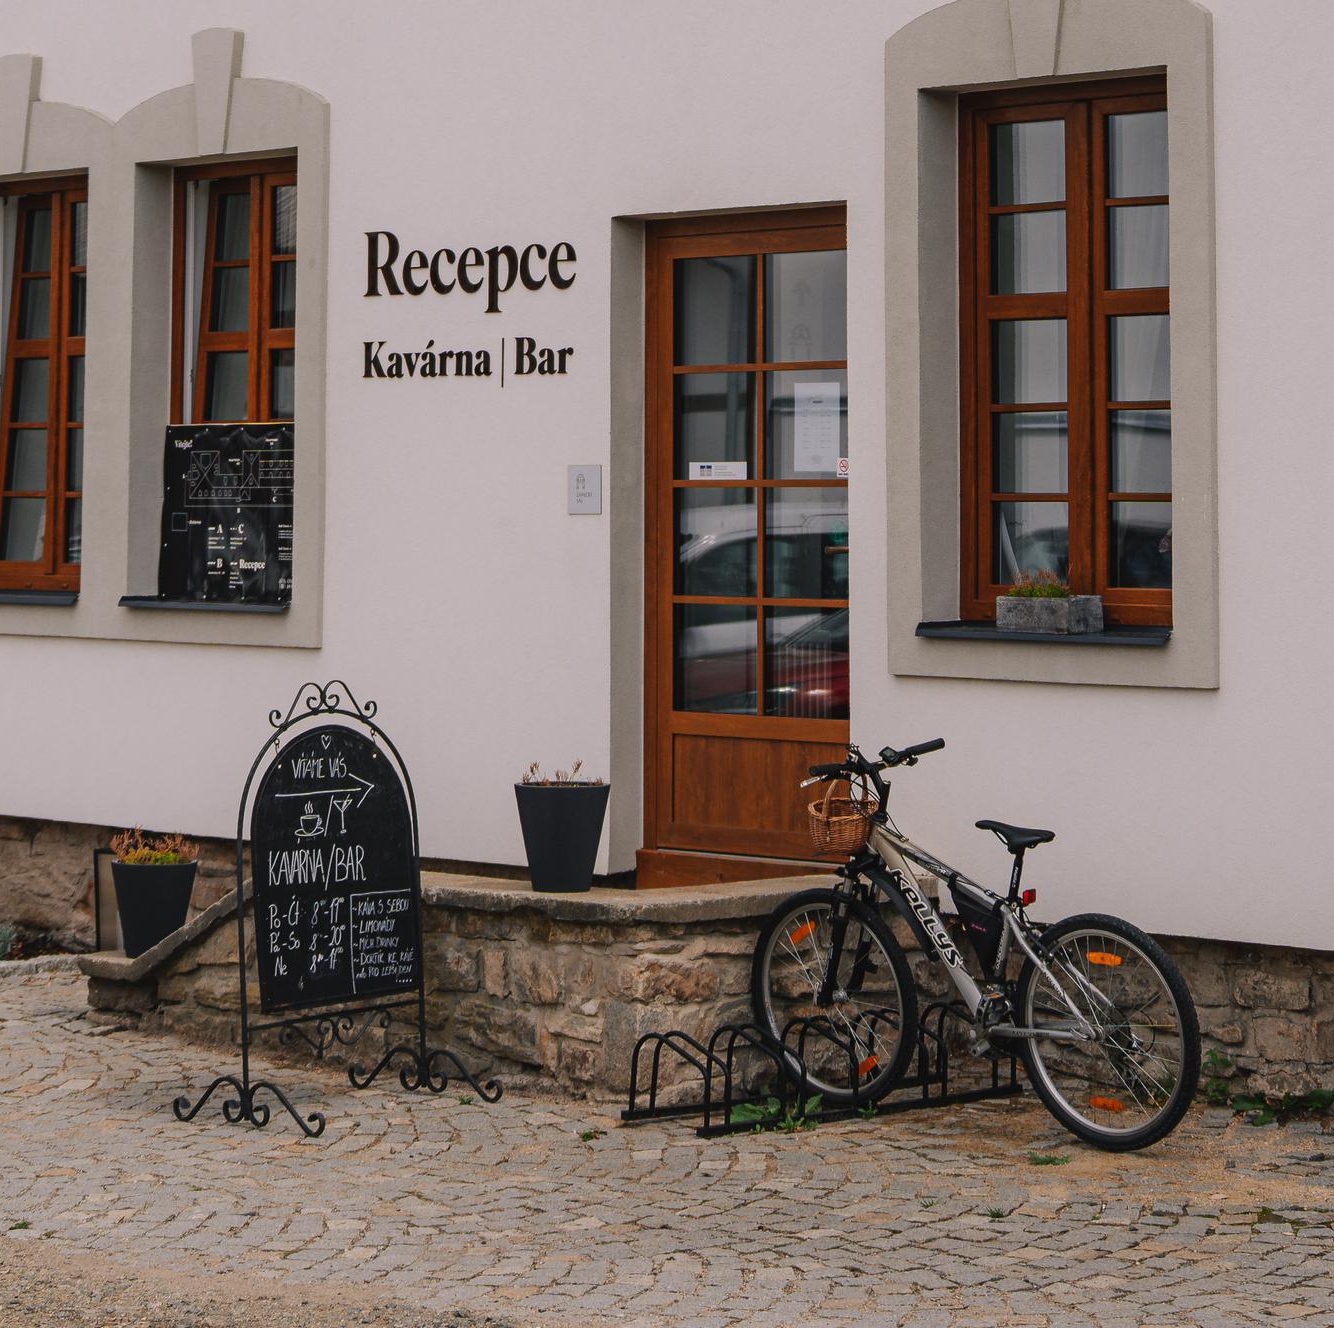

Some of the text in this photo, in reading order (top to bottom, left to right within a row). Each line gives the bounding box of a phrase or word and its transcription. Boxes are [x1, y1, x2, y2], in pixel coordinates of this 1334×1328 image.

[363, 230, 577, 313] Recepce
[362, 336, 574, 378] Kavárna Bar
[239, 558, 266, 572] Recepce
[377, 899, 384, 914] S
